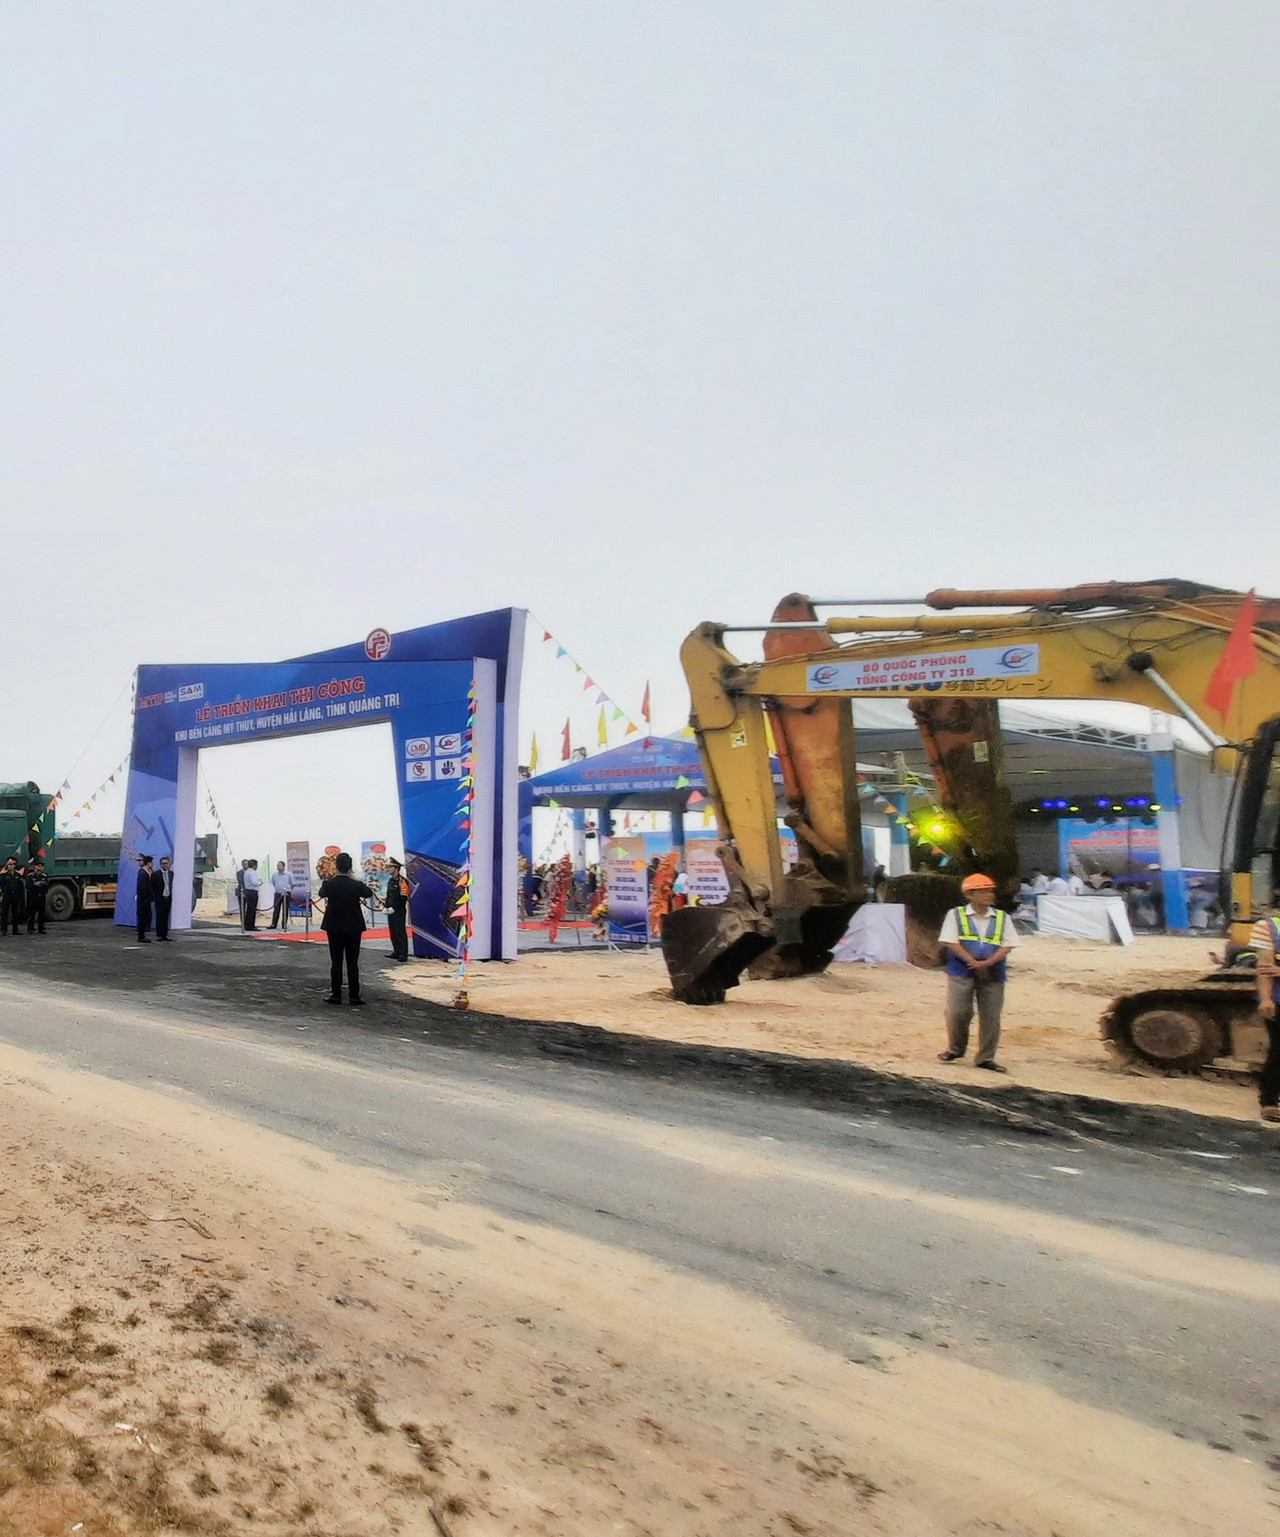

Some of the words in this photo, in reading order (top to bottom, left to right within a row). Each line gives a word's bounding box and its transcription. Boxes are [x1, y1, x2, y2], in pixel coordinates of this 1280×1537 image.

[863, 662, 879, 674] BỘ
[883, 658, 917, 671] QUỐC
[891, 671, 927, 683] CÔNG
[931, 669, 945, 679] TY
[950, 667, 975, 678] 319
[180, 685, 202, 696] SAM
[196, 701, 211, 722] LỄ
[214, 693, 251, 719] TRIỂN
[254, 692, 287, 712] KHAI
[289, 686, 315, 705] THI
[318, 676, 365, 699] CÔNG
[175, 730, 188, 742] KHU
[189, 725, 202, 739] BẾN
[203, 722, 222, 738] CẢNG
[256, 713, 282, 730] HUYỆN
[283, 708, 298, 724] HẢI
[326, 700, 347, 717] TỈNH
[348, 694, 381, 715] QUẢNG
[383, 693, 400, 709] TRỊ
